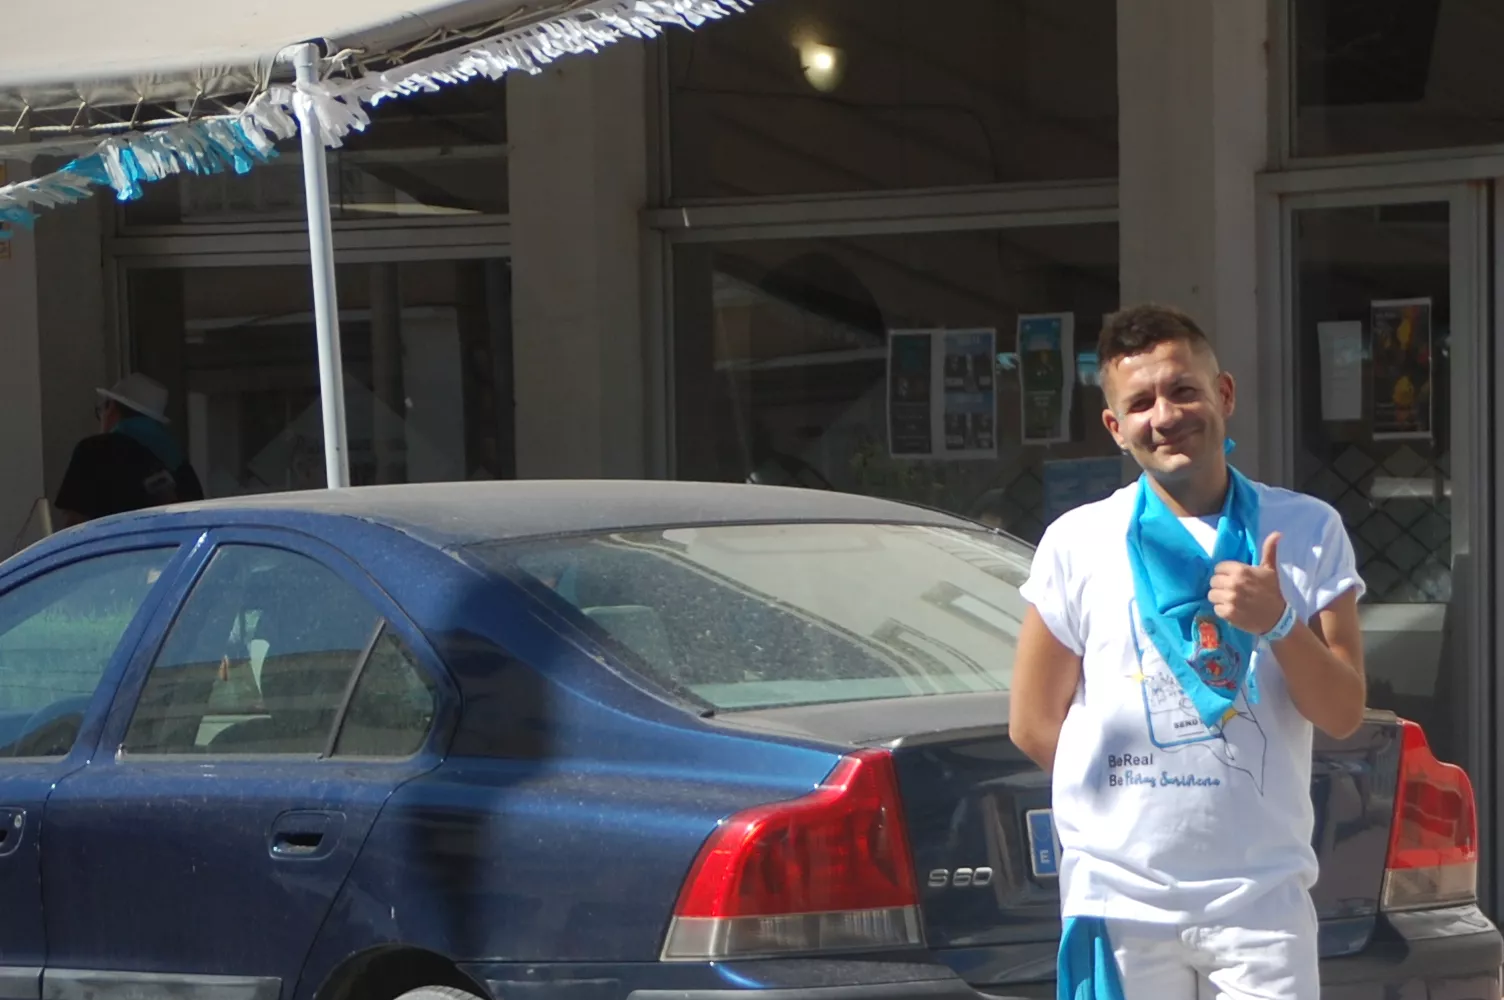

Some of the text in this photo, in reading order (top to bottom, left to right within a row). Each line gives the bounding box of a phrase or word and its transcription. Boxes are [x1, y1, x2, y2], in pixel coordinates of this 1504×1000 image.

[1108, 753, 1154, 768] BeReal
[1109, 774, 1124, 787] Be
[1039, 849, 1051, 864] E
[927, 866, 993, 888] S60
